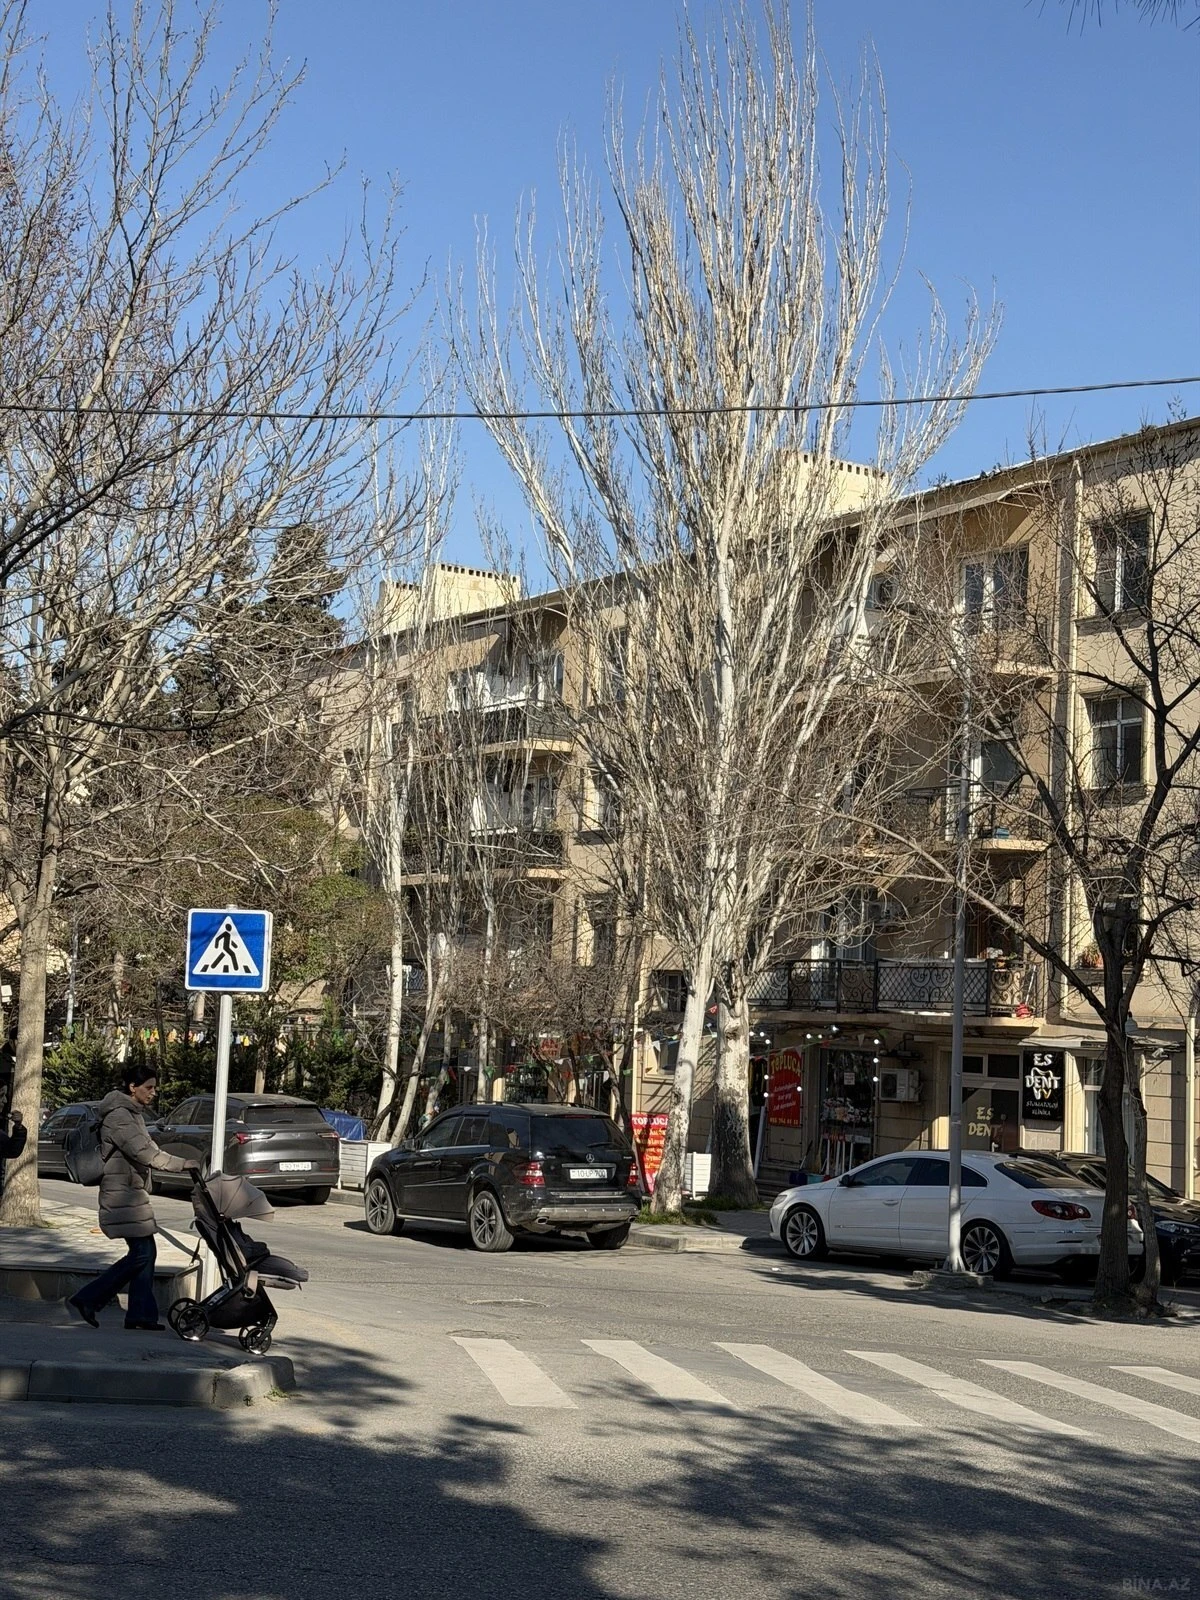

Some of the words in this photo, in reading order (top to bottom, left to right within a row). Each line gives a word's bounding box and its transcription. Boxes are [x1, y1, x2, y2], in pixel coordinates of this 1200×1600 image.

[771, 1055, 801, 1077] TOPLUCA
[1033, 1053, 1053, 1066] ES
[1024, 1076, 1061, 1090] DENT
[976, 1106, 994, 1120] ES
[968, 1122, 1001, 1138] DENT
